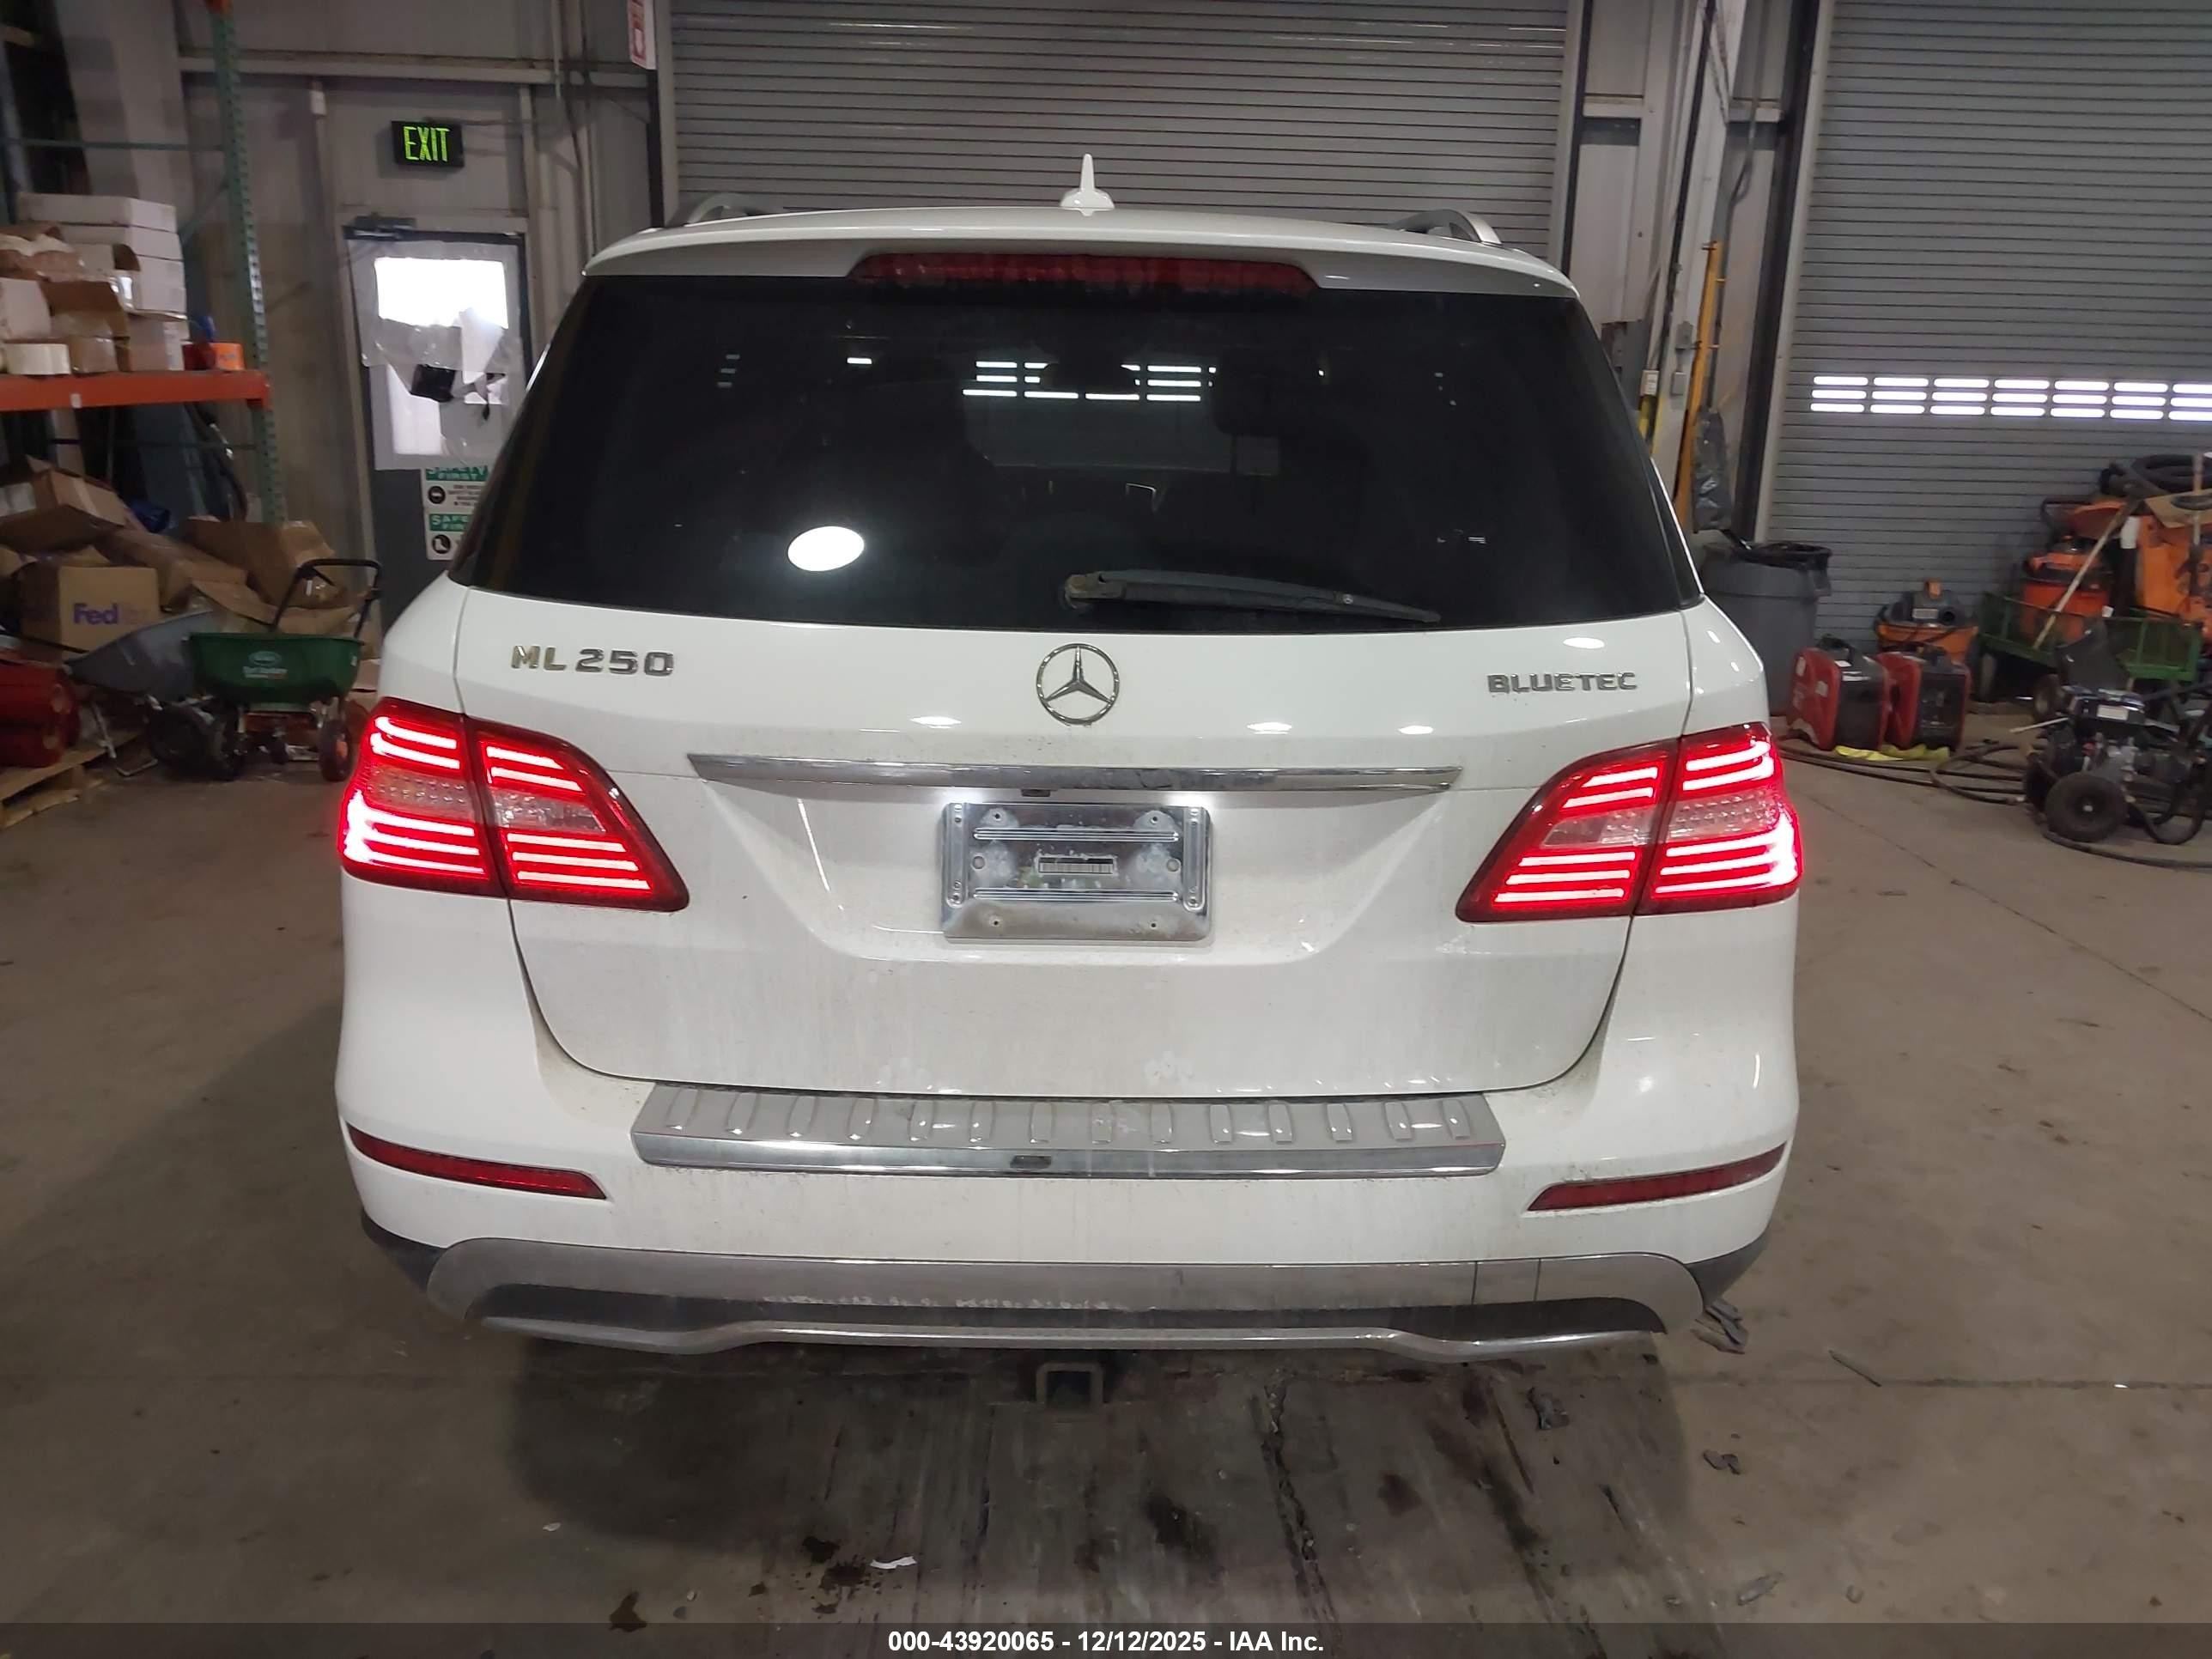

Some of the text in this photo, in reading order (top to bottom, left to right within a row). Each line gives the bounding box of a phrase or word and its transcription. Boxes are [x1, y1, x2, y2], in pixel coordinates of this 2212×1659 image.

[404, 126, 450, 161] EXIT
[511, 645, 674, 677] ML 250
[1487, 672, 1638, 693] BLUETEC
